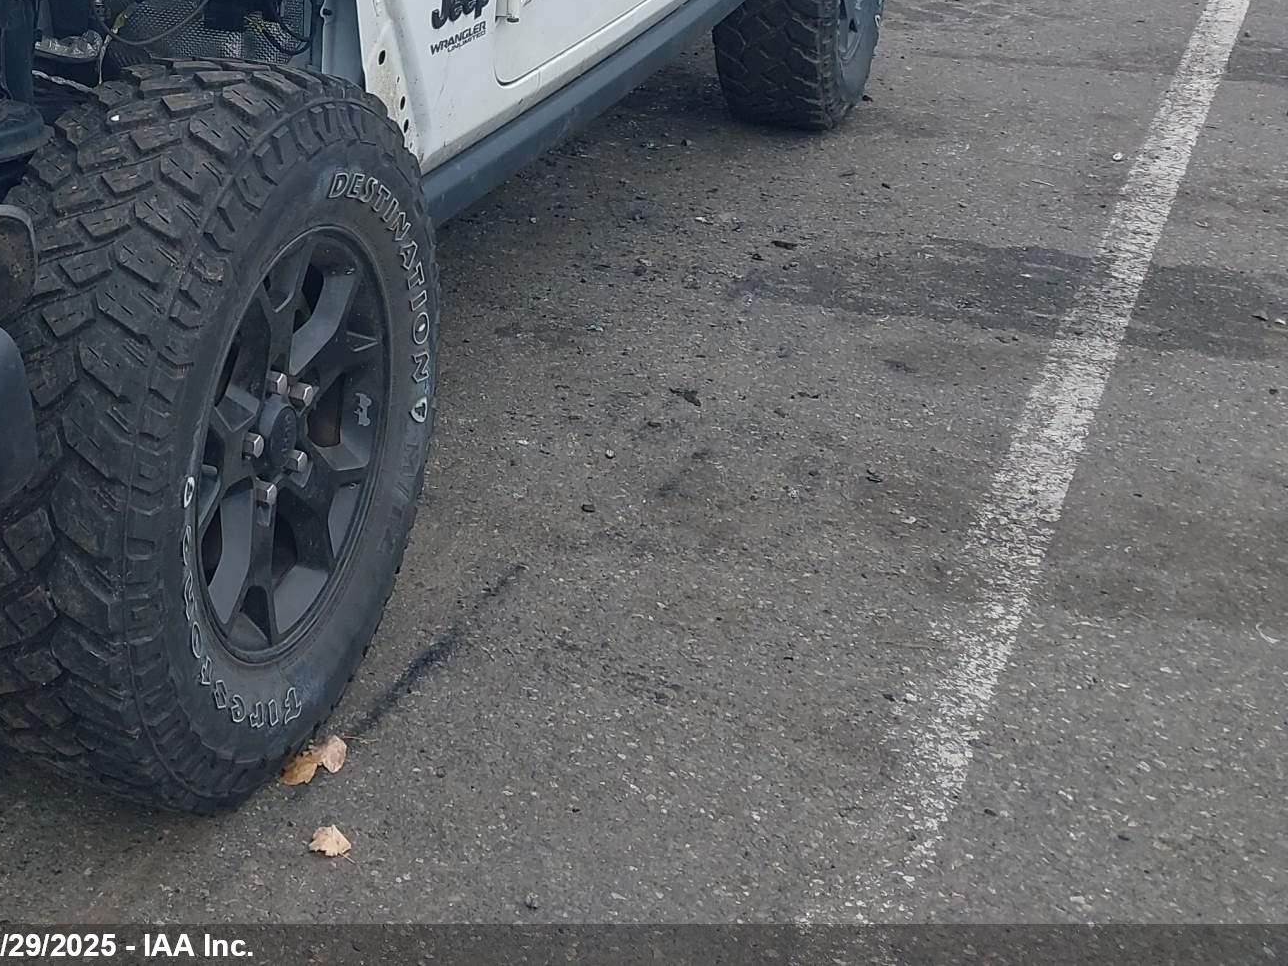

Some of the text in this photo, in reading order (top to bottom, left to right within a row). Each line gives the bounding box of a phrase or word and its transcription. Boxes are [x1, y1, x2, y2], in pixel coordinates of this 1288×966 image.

[430, 21, 487, 55] WRANGLER
[447, 30, 486, 52] UNLIMITED
[327, 171, 431, 384] DESTINATION
